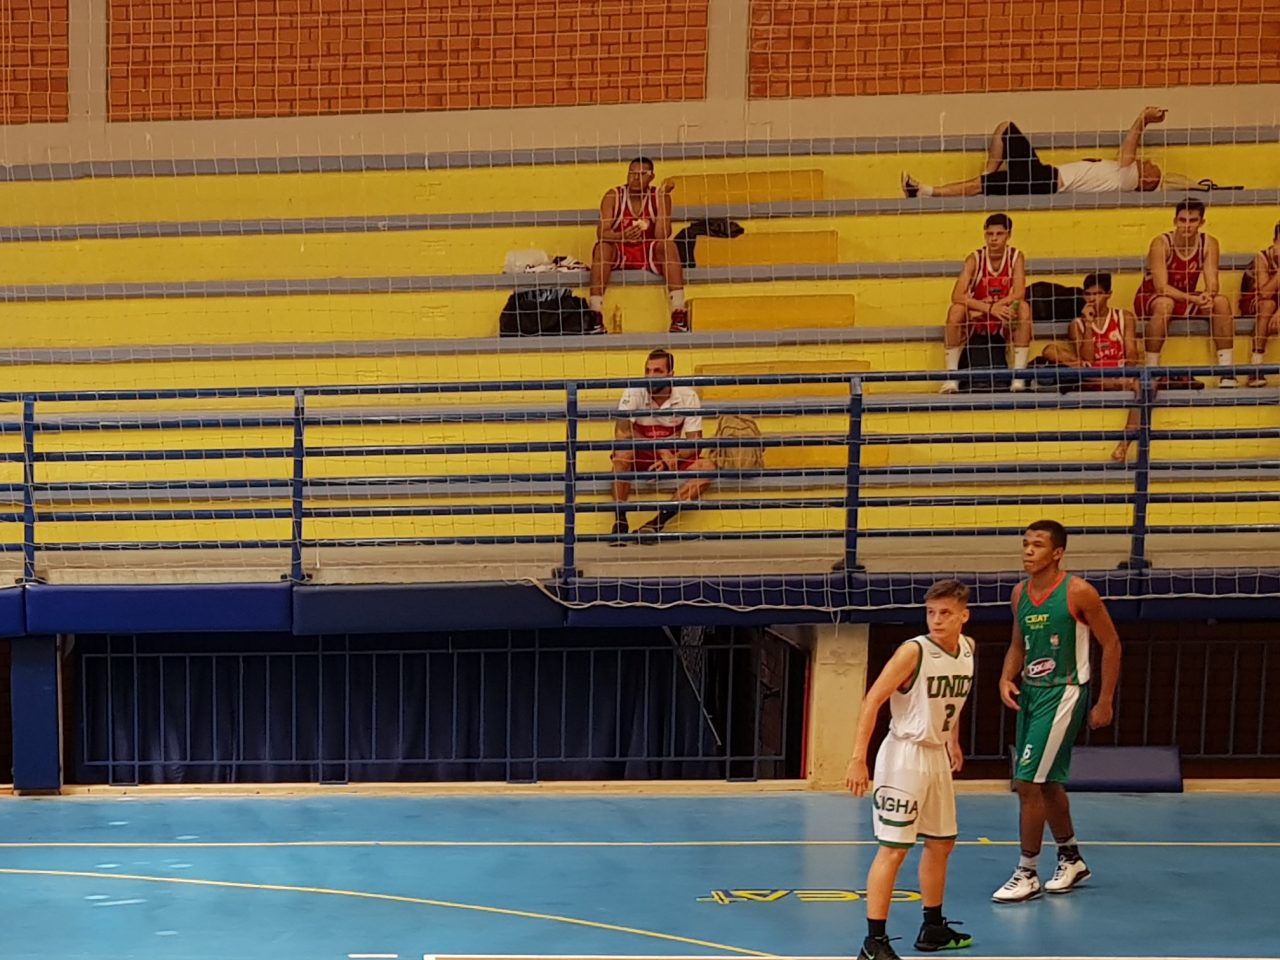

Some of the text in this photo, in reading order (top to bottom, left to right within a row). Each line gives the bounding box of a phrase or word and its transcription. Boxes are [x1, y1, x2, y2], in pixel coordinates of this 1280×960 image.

[1025, 614, 1049, 624] CEAT
[942, 703, 956, 732] 2
[878, 795, 919, 815] IGHA
